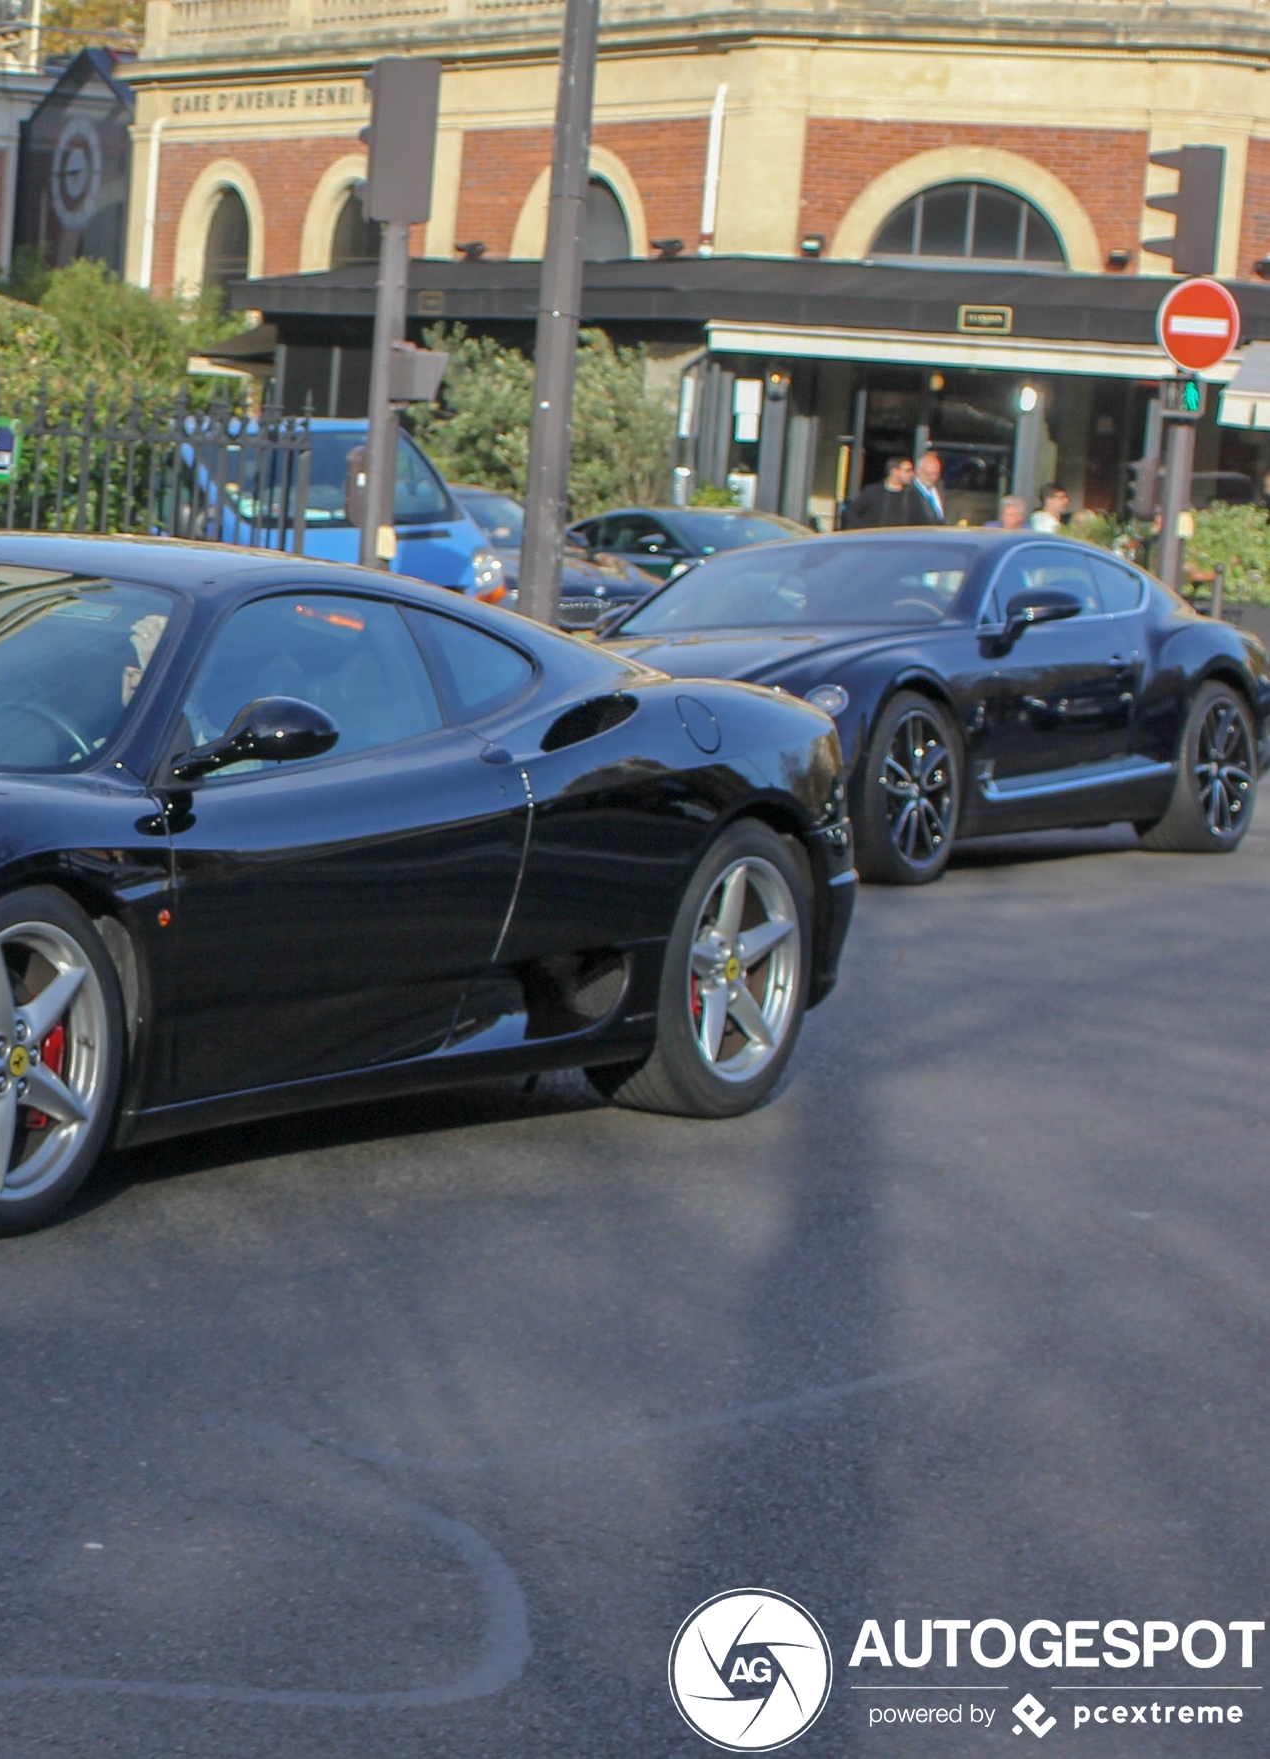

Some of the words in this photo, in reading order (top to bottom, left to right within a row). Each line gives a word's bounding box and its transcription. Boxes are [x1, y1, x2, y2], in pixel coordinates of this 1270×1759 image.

[172, 93, 210, 114] GARE
[218, 89, 297, 111] D'AVENUE
[304, 86, 354, 107] HENRI
